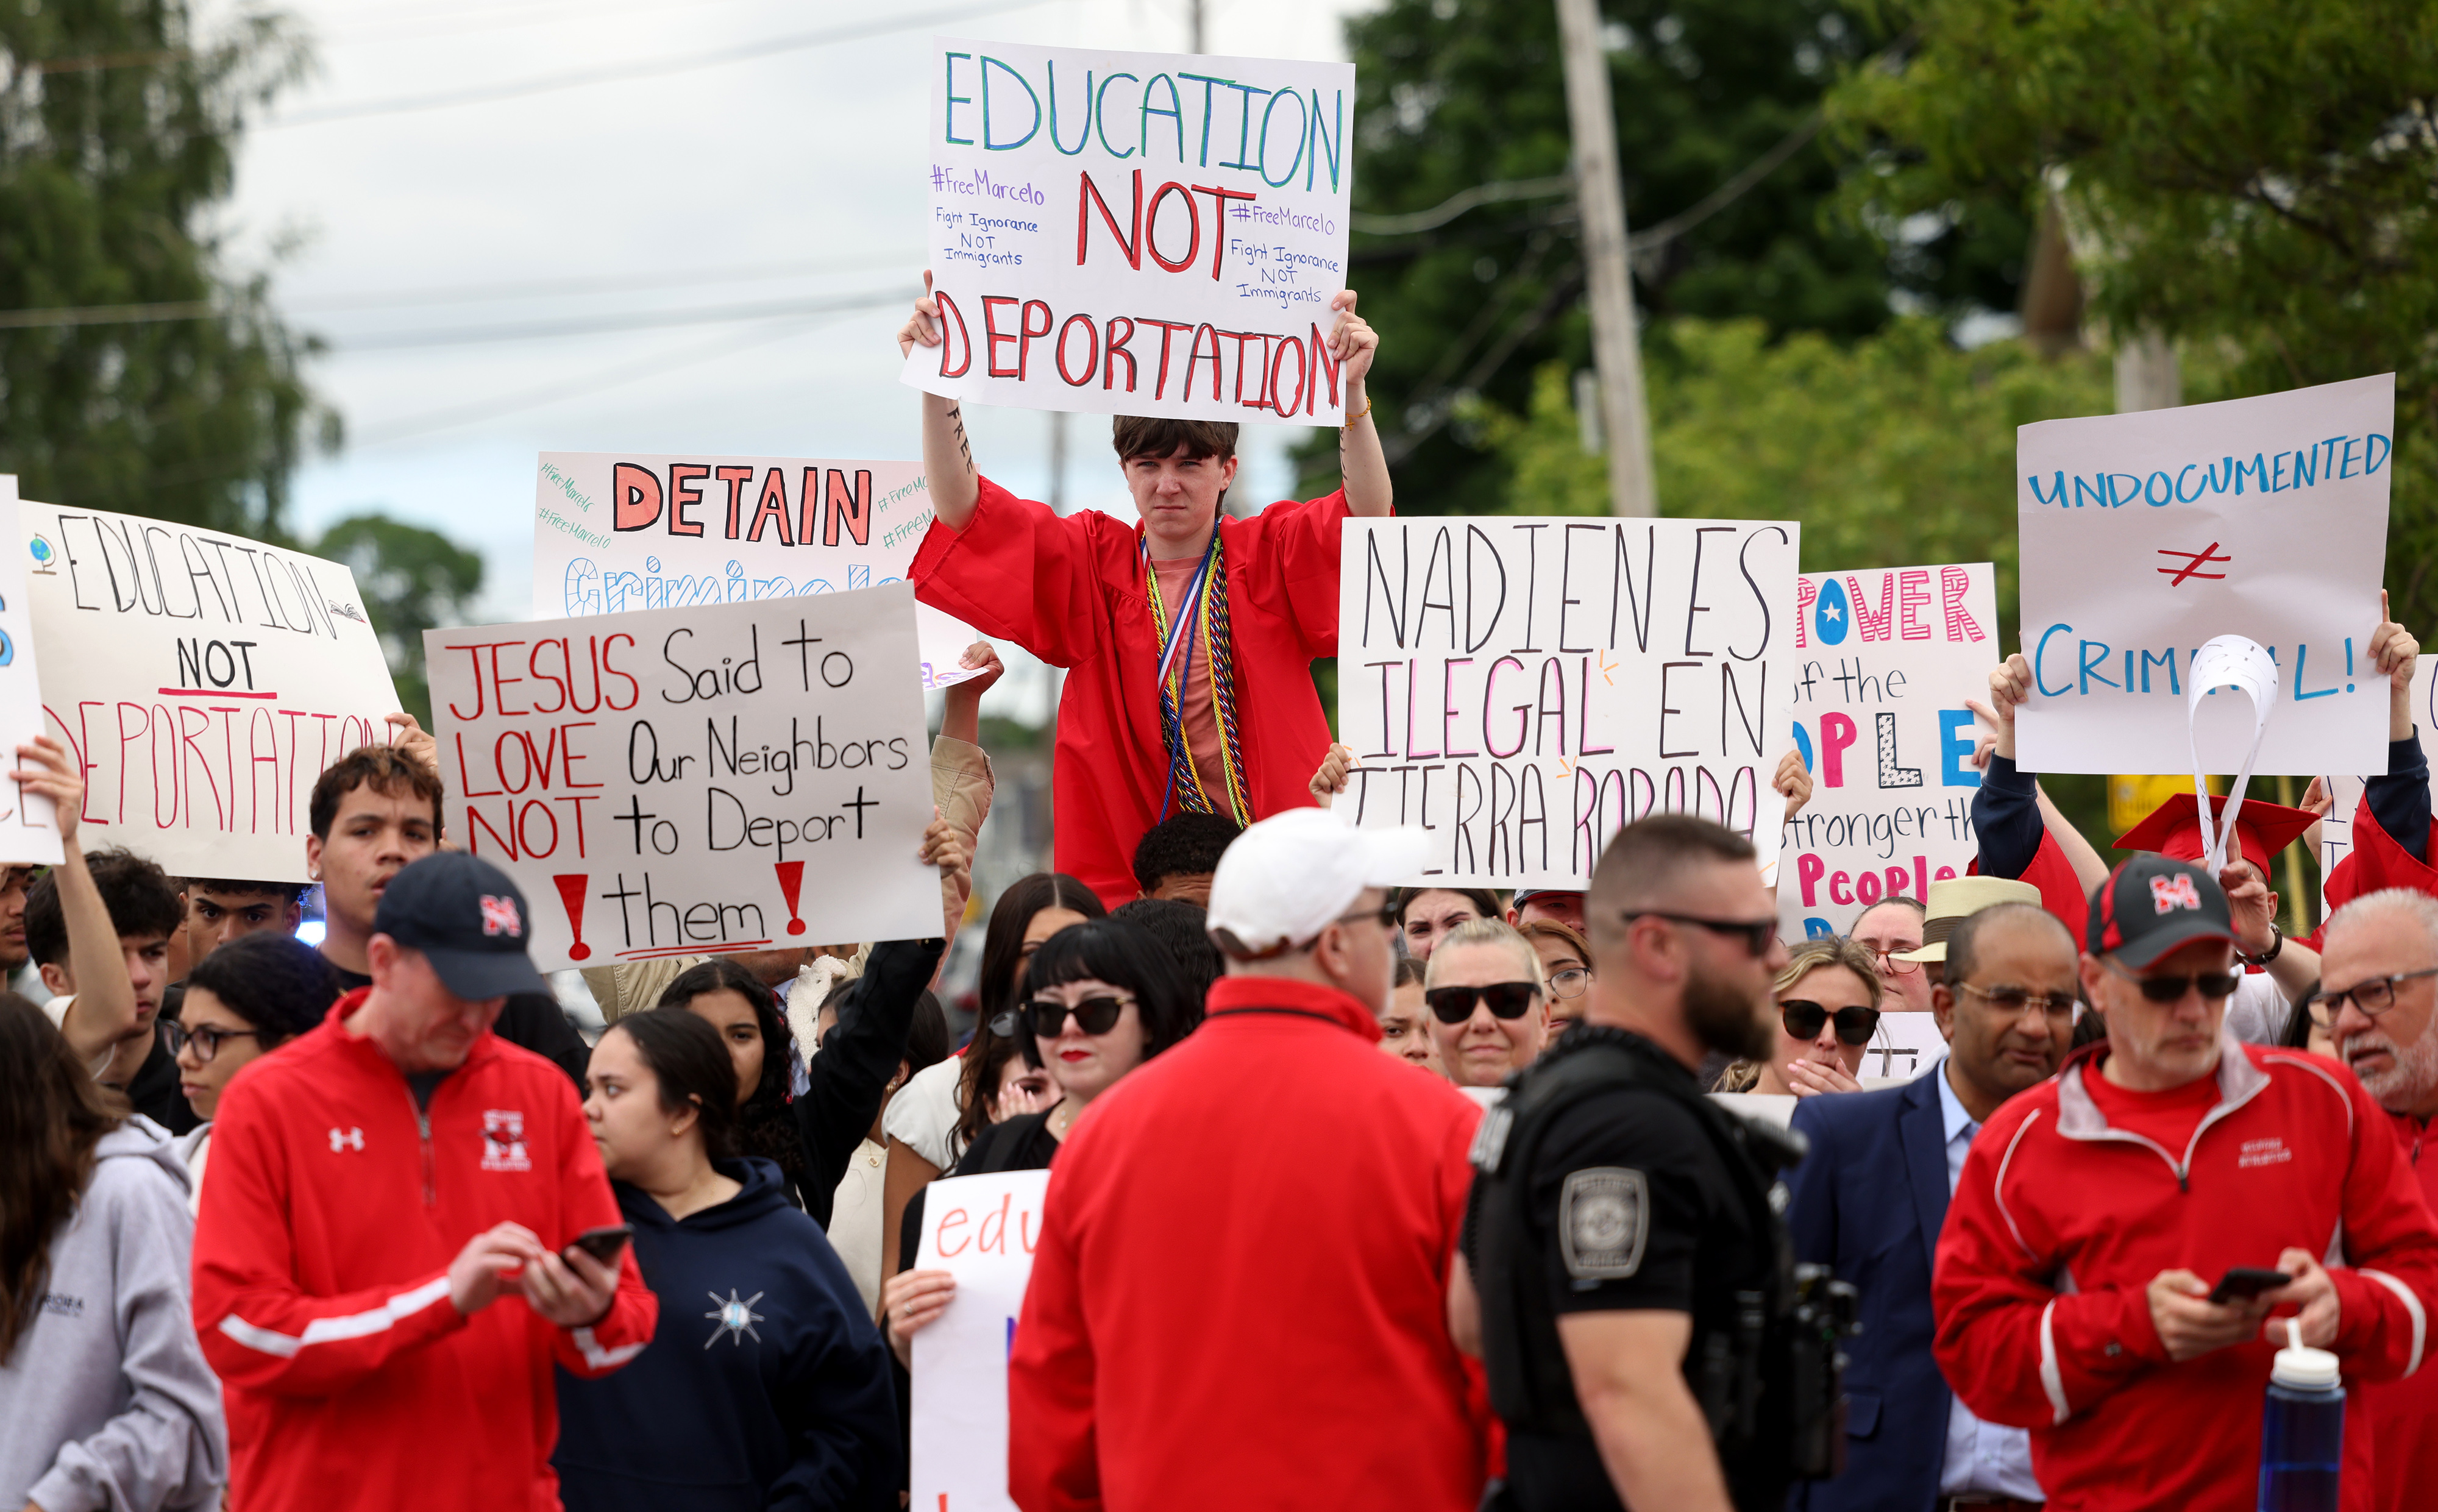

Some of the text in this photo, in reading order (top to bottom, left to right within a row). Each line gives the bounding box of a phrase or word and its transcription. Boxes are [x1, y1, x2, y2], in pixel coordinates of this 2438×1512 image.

[945, 51, 1342, 194] EDUCATION
[929, 164, 1045, 205] #FreeMarcelo
[936, 207, 1038, 232] Fight Ignorance
[961, 232, 995, 249] NOT
[1076, 169, 1257, 282] NOT
[1229, 202, 1335, 235] #FreeMarcelo
[944, 248, 1023, 268] Immigrants
[1231, 239, 1338, 272] Fight Ignorance
[1262, 268, 1298, 284] NOT
[1236, 283, 1321, 309] Immigrants
[935, 290, 1340, 419] DEPORTATION
[947, 406, 973, 475] FREE
[2028, 433, 2392, 509] UNDOCUMENTED
[538, 508, 611, 548] #FreeMarcelo
[613, 462, 872, 546] DETAIN
[58, 514, 338, 640] EDUCATION
[1796, 566, 1986, 648] POWER
[177, 637, 257, 690] NOT
[445, 618, 854, 720] JESUS Said to
[1794, 656, 1907, 704] f the
[1362, 655, 1766, 762] ILEGAL EN
[455, 714, 909, 797] LOVE Our Neighbors
[466, 786, 880, 862] NOT to Deport
[1780, 806, 1937, 859] tronger
[2149, 873, 2202, 915] M
